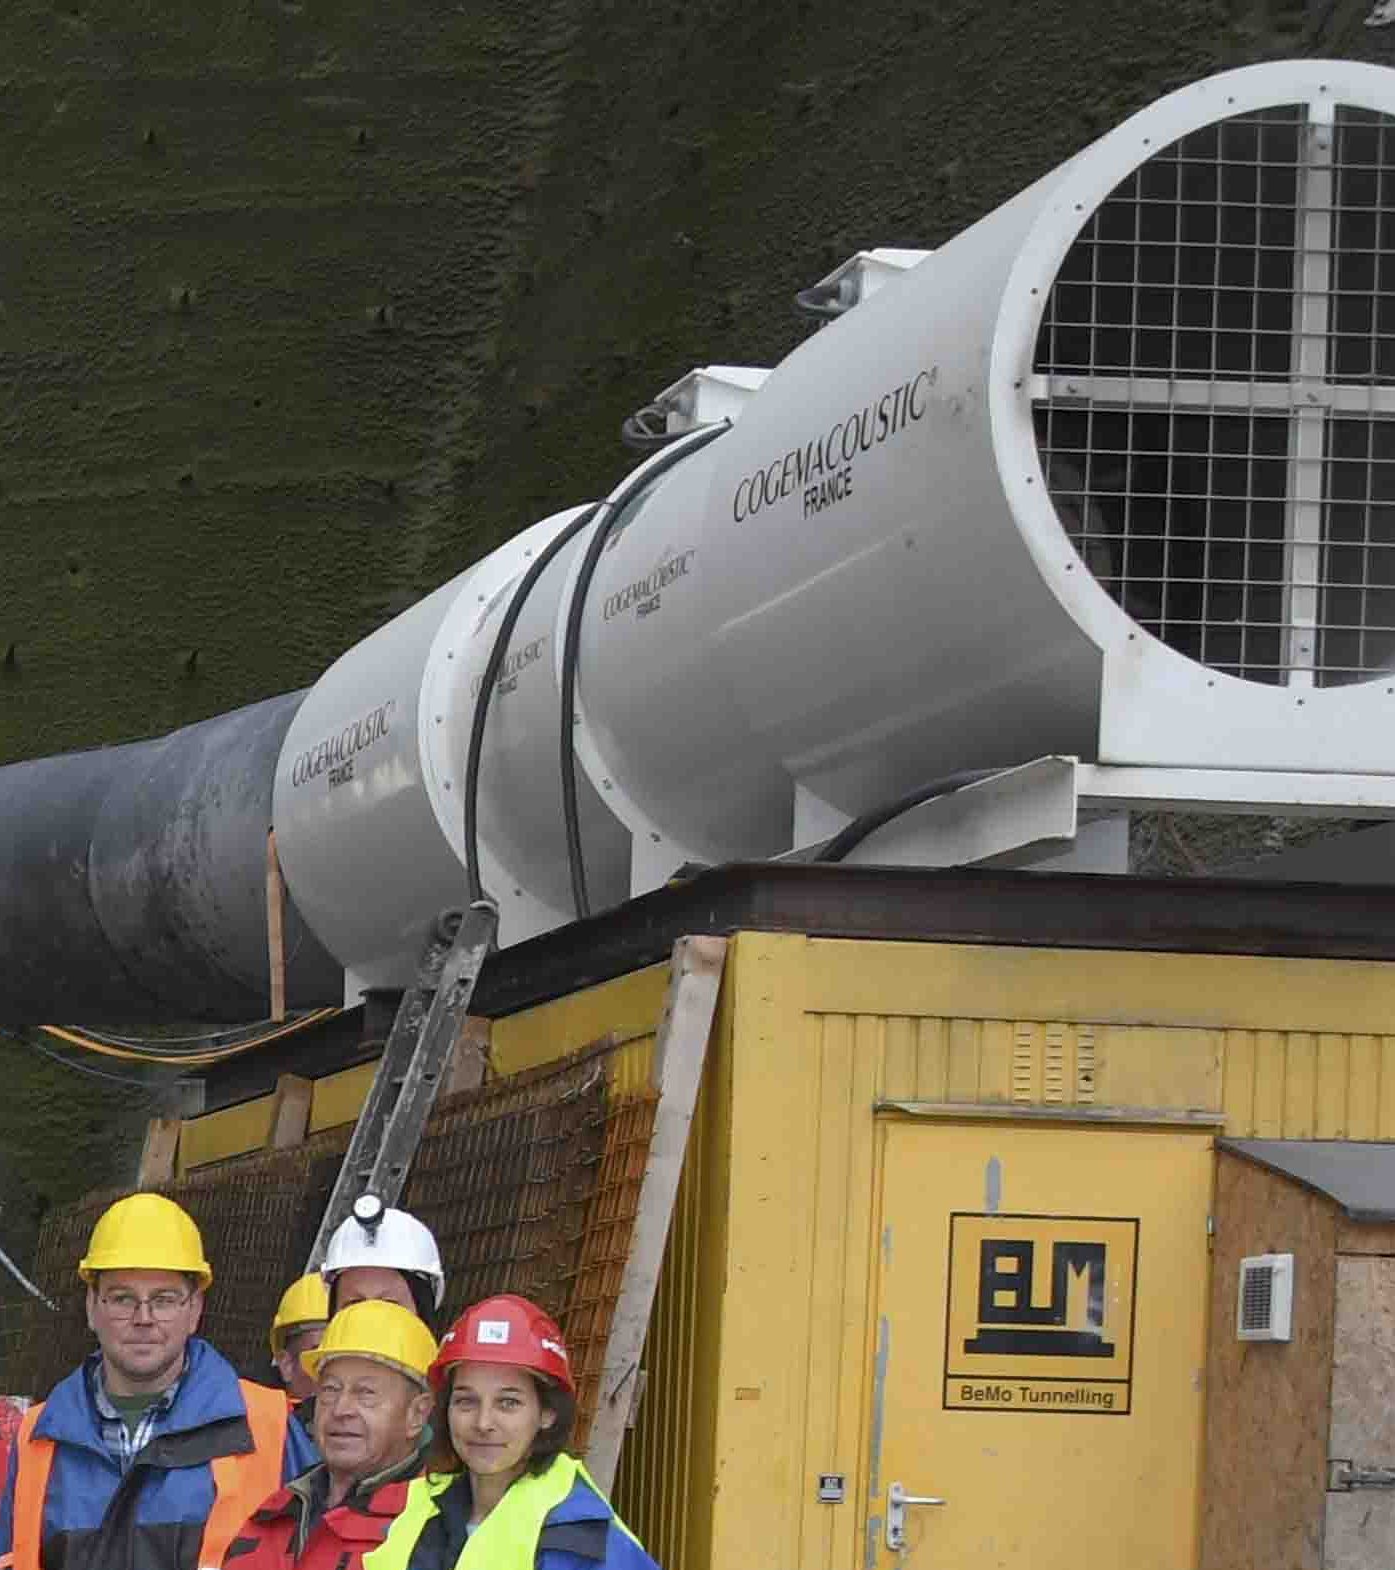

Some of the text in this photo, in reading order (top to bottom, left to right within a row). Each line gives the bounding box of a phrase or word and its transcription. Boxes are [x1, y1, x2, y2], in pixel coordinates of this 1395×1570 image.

[734, 371, 927, 523] COGEMACOUSTIC
[803, 466, 853, 520] FRANCE
[960, 1385, 1115, 1408] BeMo Tunnelling
